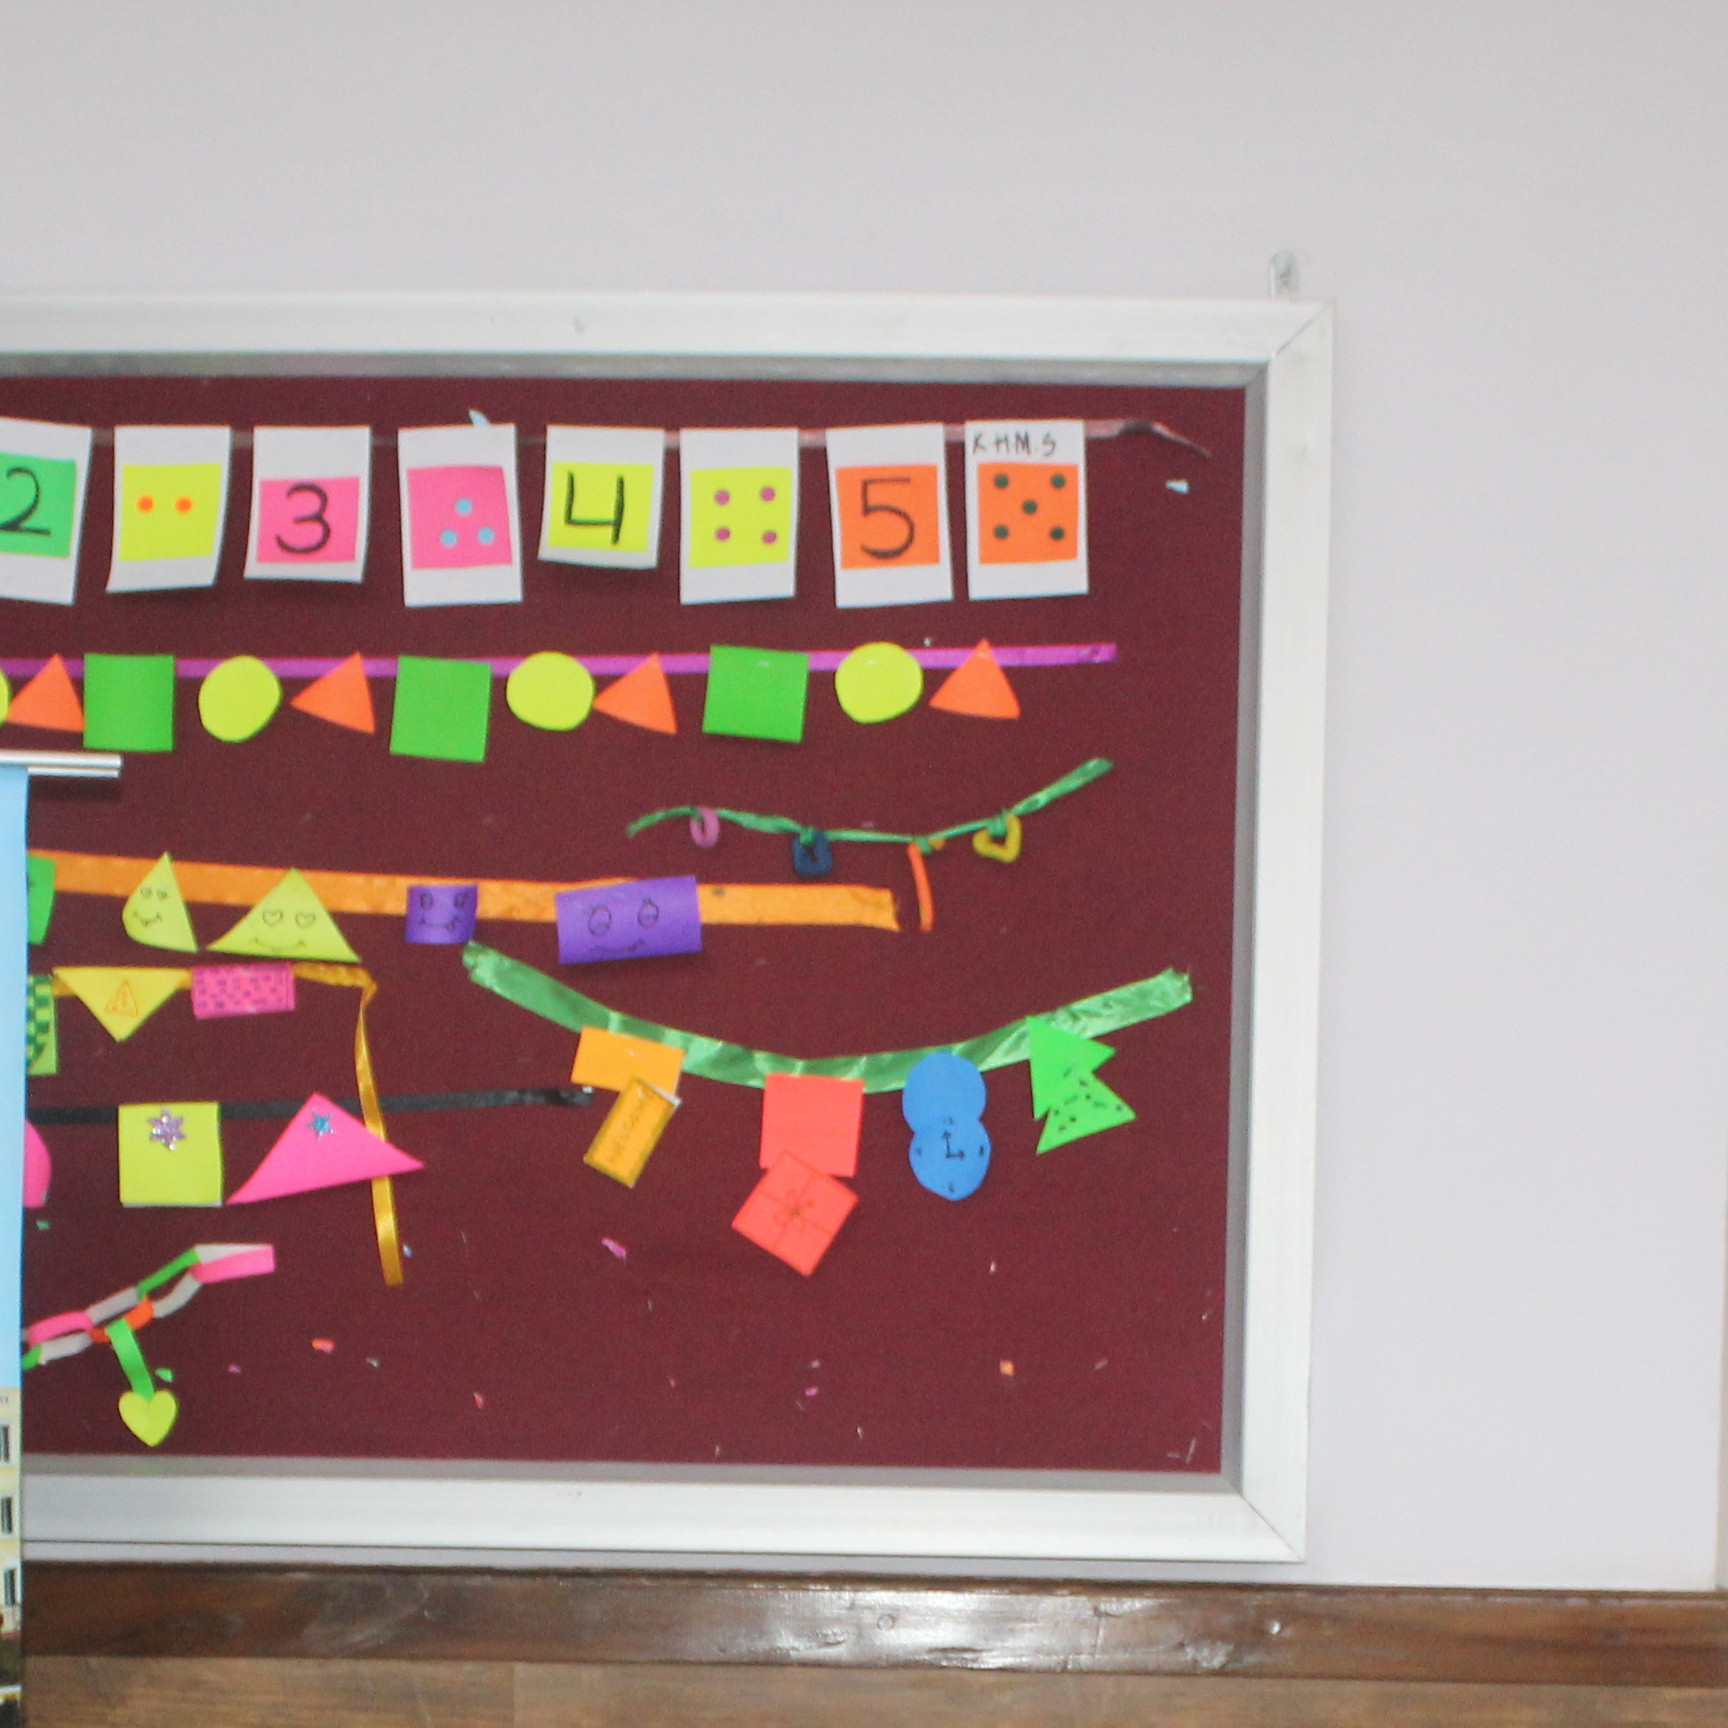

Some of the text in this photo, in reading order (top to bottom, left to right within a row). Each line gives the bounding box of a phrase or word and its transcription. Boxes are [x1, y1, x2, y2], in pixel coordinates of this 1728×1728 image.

[275, 481, 332, 555] 3
[563, 466, 626, 545] 4
[858, 476, 917, 560] 5
